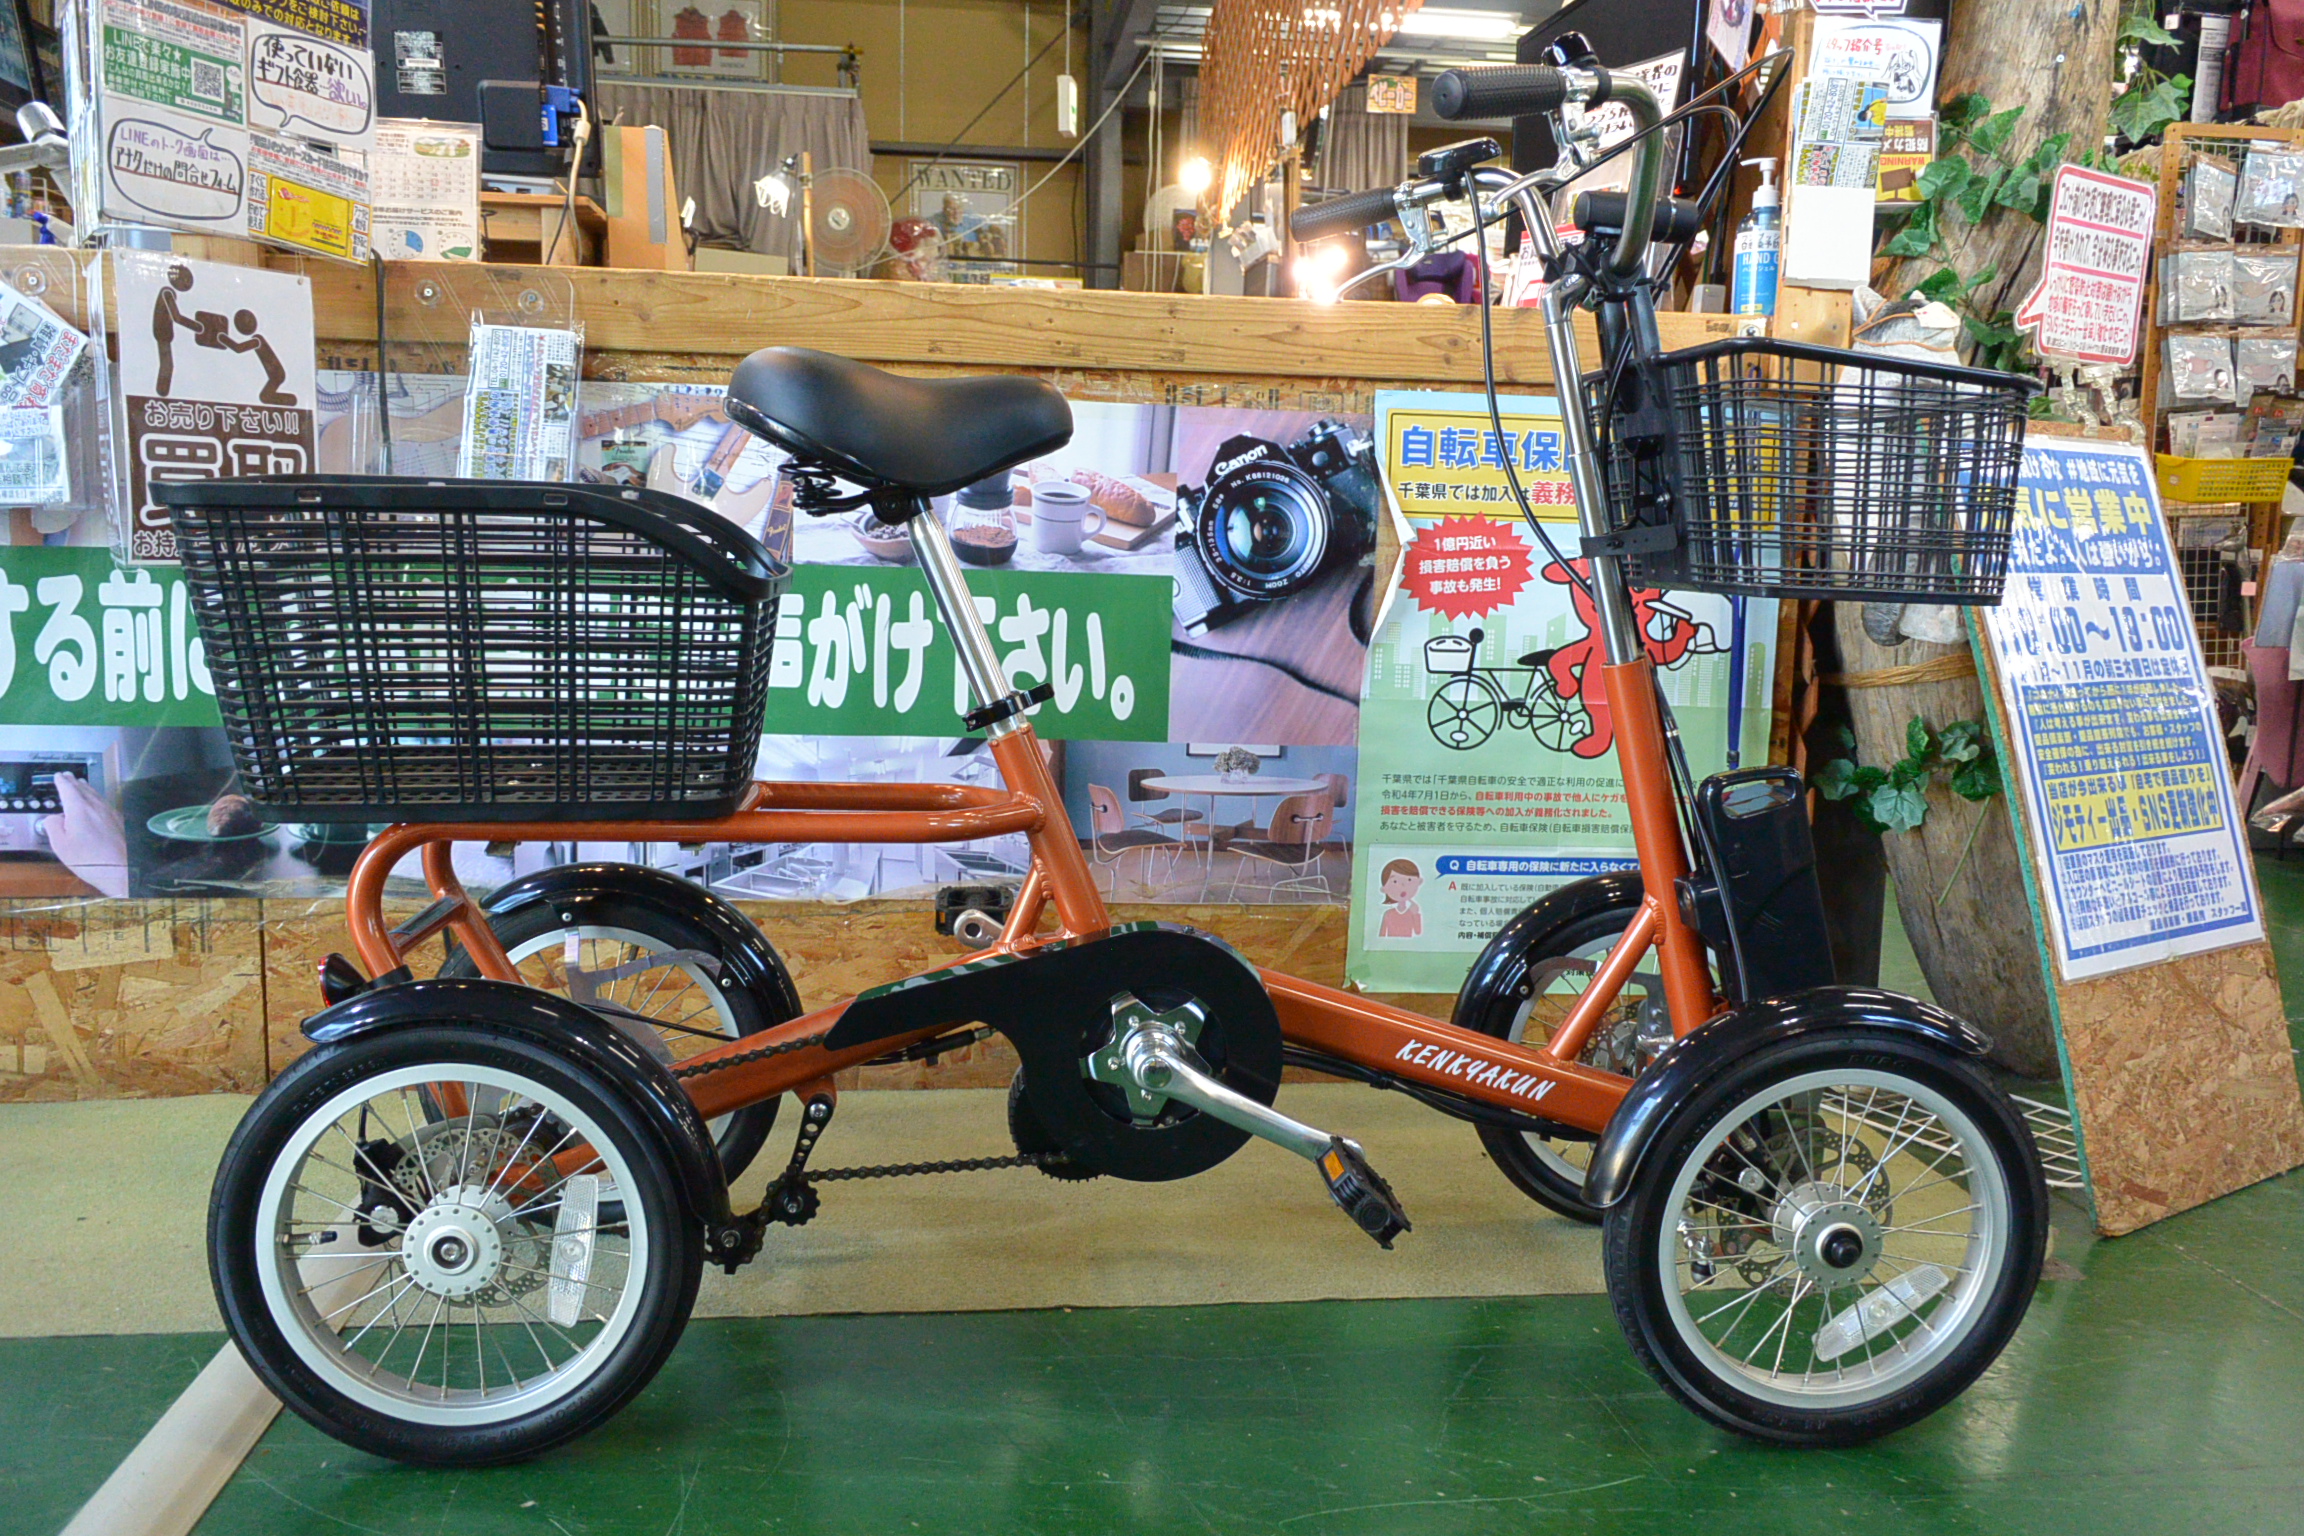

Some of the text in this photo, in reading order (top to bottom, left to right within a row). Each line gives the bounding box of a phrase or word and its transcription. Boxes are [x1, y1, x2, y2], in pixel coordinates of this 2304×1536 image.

[263, 36, 353, 80] 使っていない
[1880, 156, 1926, 166] WARNING
[915, 168, 1012, 191] WANTED
[1400, 424, 1568, 472] 自転車保
[1215, 444, 1268, 476] Canon
[1434, 535, 1497, 553] 1億円近い
[1419, 555, 1512, 576] 損害賠償を負う
[1265, 578, 1289, 590] ZOOM
[1380, 805, 1614, 819] 損害を賠償できる保険等への加入が義務化されました。
[1449, 860, 1460, 872] Q
[1448, 880, 1457, 891] A
[1459, 907, 1526, 917] また、個人賠償責
[1458, 918, 1509, 929] なっている場
[1395, 1038, 1557, 1101] KENKYAKUN
